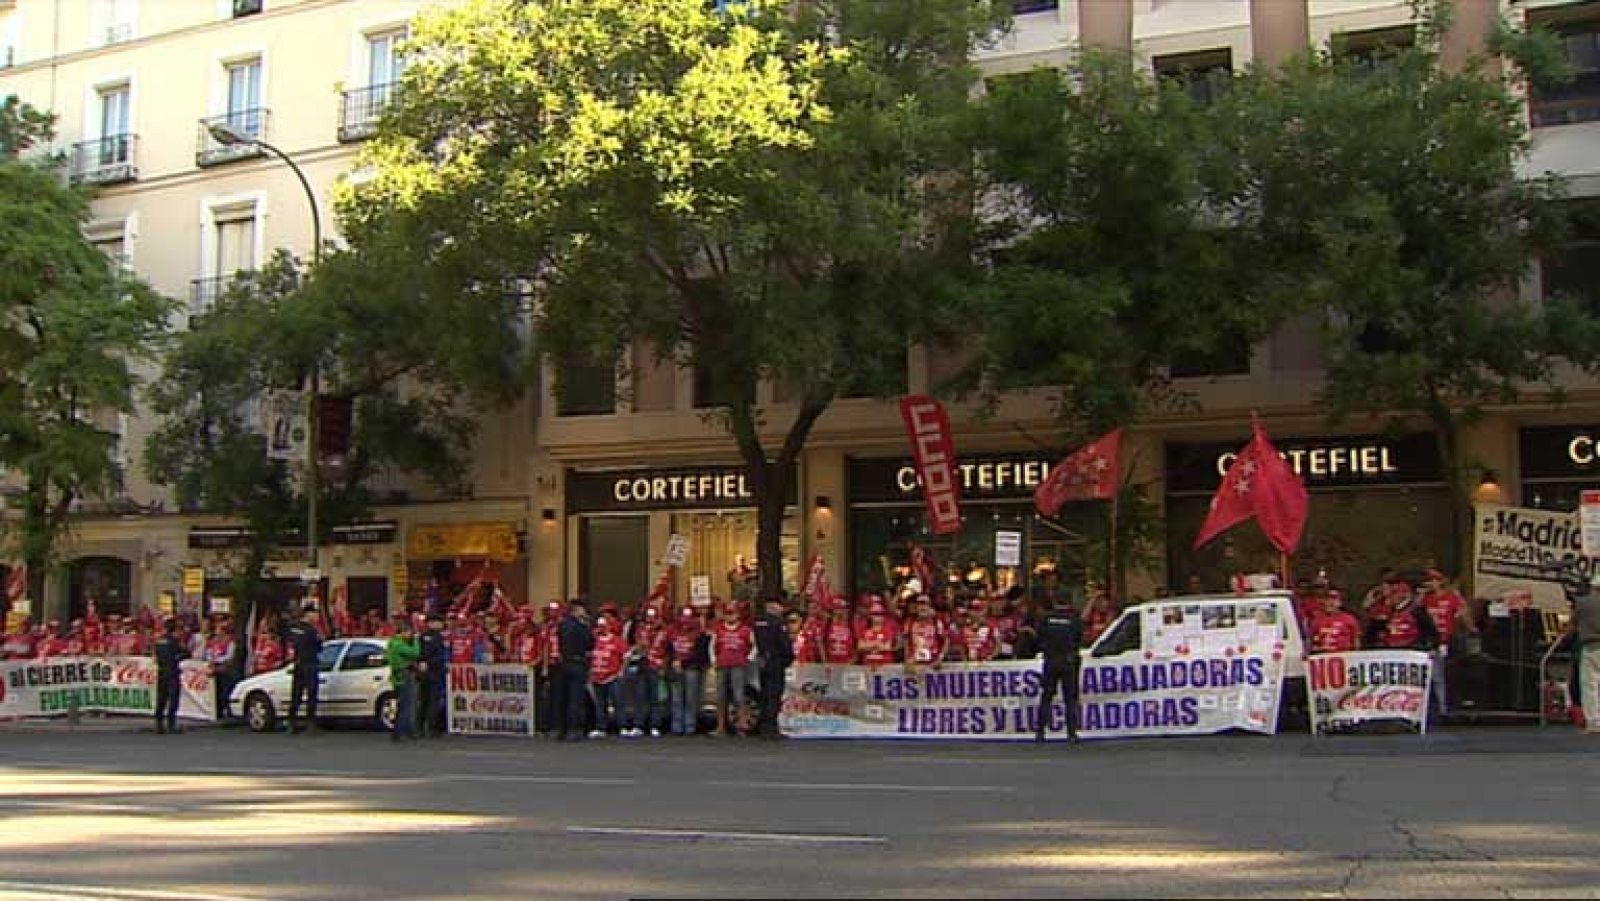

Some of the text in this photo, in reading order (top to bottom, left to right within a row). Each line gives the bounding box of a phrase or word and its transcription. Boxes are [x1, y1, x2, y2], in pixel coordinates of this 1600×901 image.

[1216, 447, 1397, 476] CTEFIEL
[1569, 435, 1600, 464] C
[615, 475, 752, 501] CORTEFIEL
[898, 461, 1049, 491] CTEFIE
[451, 667, 478, 692] NO
[872, 658, 1264, 700] Las MUJERES ABAJADORAS
[1311, 657, 1345, 691] NO
[898, 704, 986, 734] LIBRES
[1014, 696, 1199, 733] LUCADORAS
